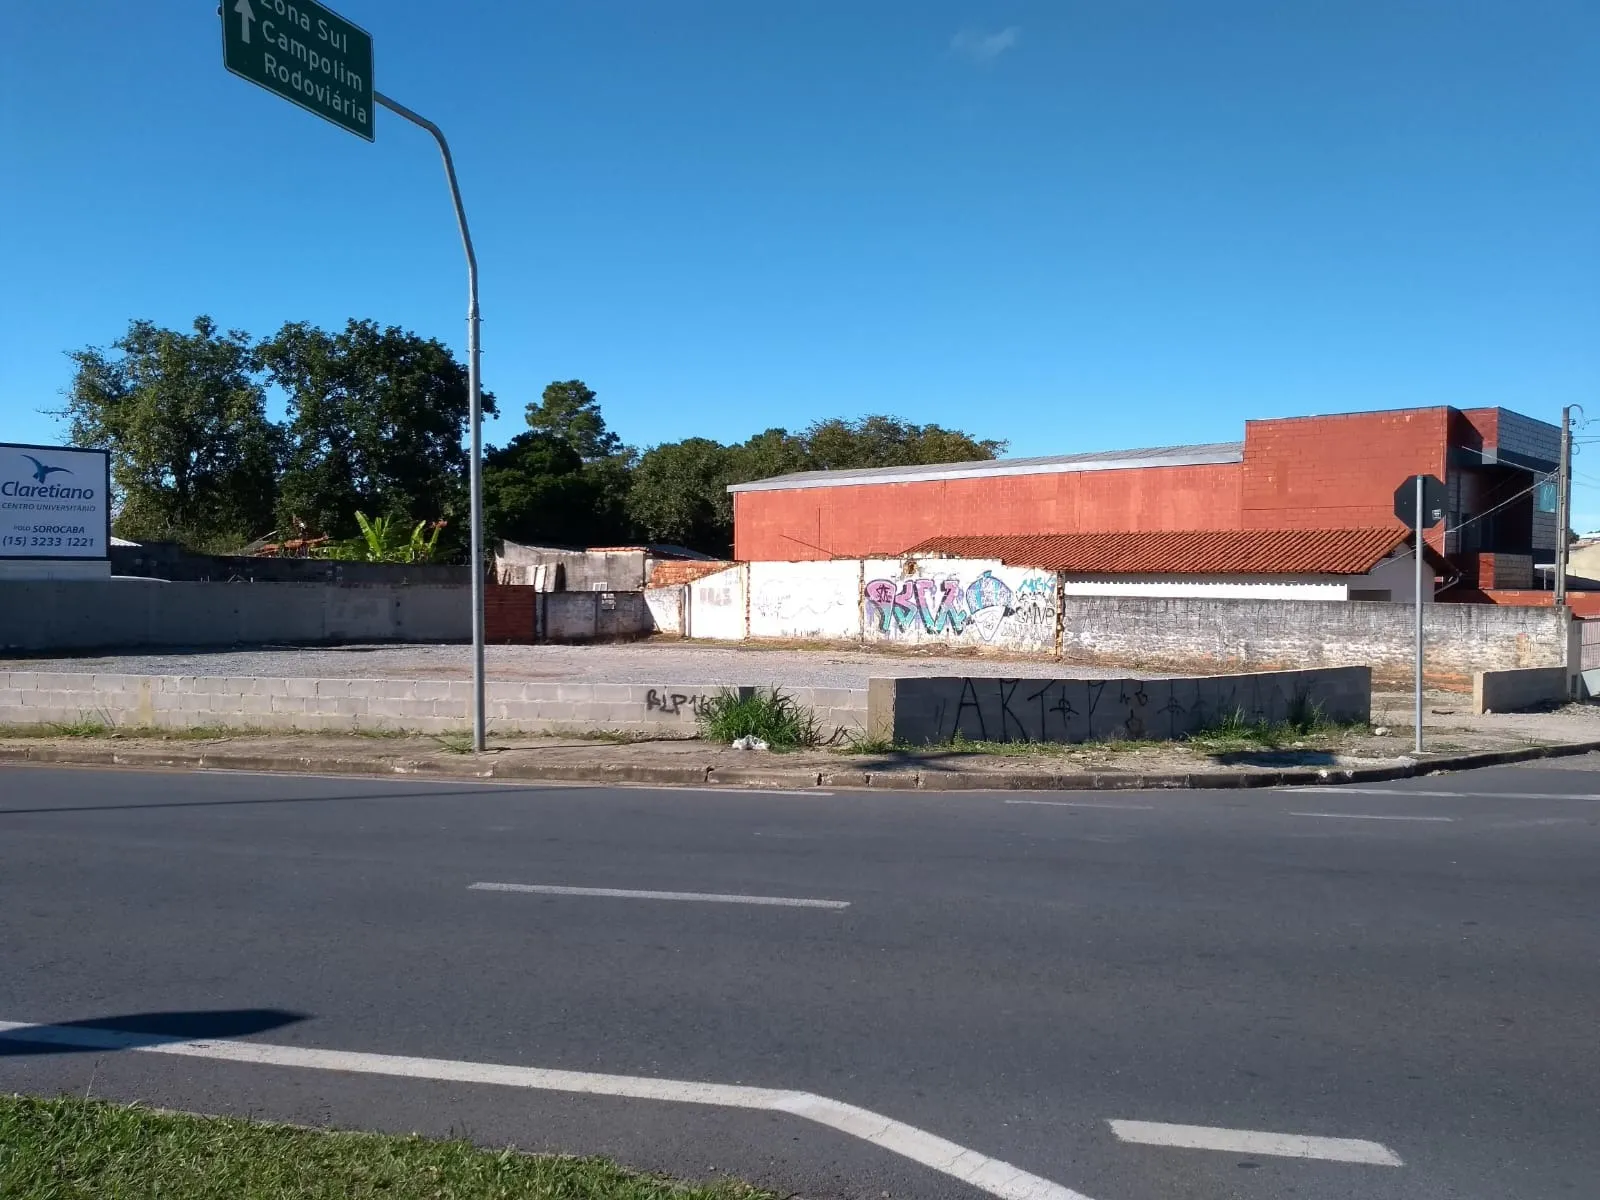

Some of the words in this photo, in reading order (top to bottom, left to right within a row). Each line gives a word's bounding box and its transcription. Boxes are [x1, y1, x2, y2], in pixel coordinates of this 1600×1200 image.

[317, 19, 347, 54] Sul
[262, 20, 363, 92] Campolim
[264, 52, 367, 124] Rodoviária
[1, 481, 94, 500] Claretiano
[1, 502, 35, 510] CENTRO
[32, 525, 85, 534] SOROCABA
[2, 536, 27, 547] (15)
[30, 537, 62, 547] 3233
[67, 537, 94, 547] 1221
